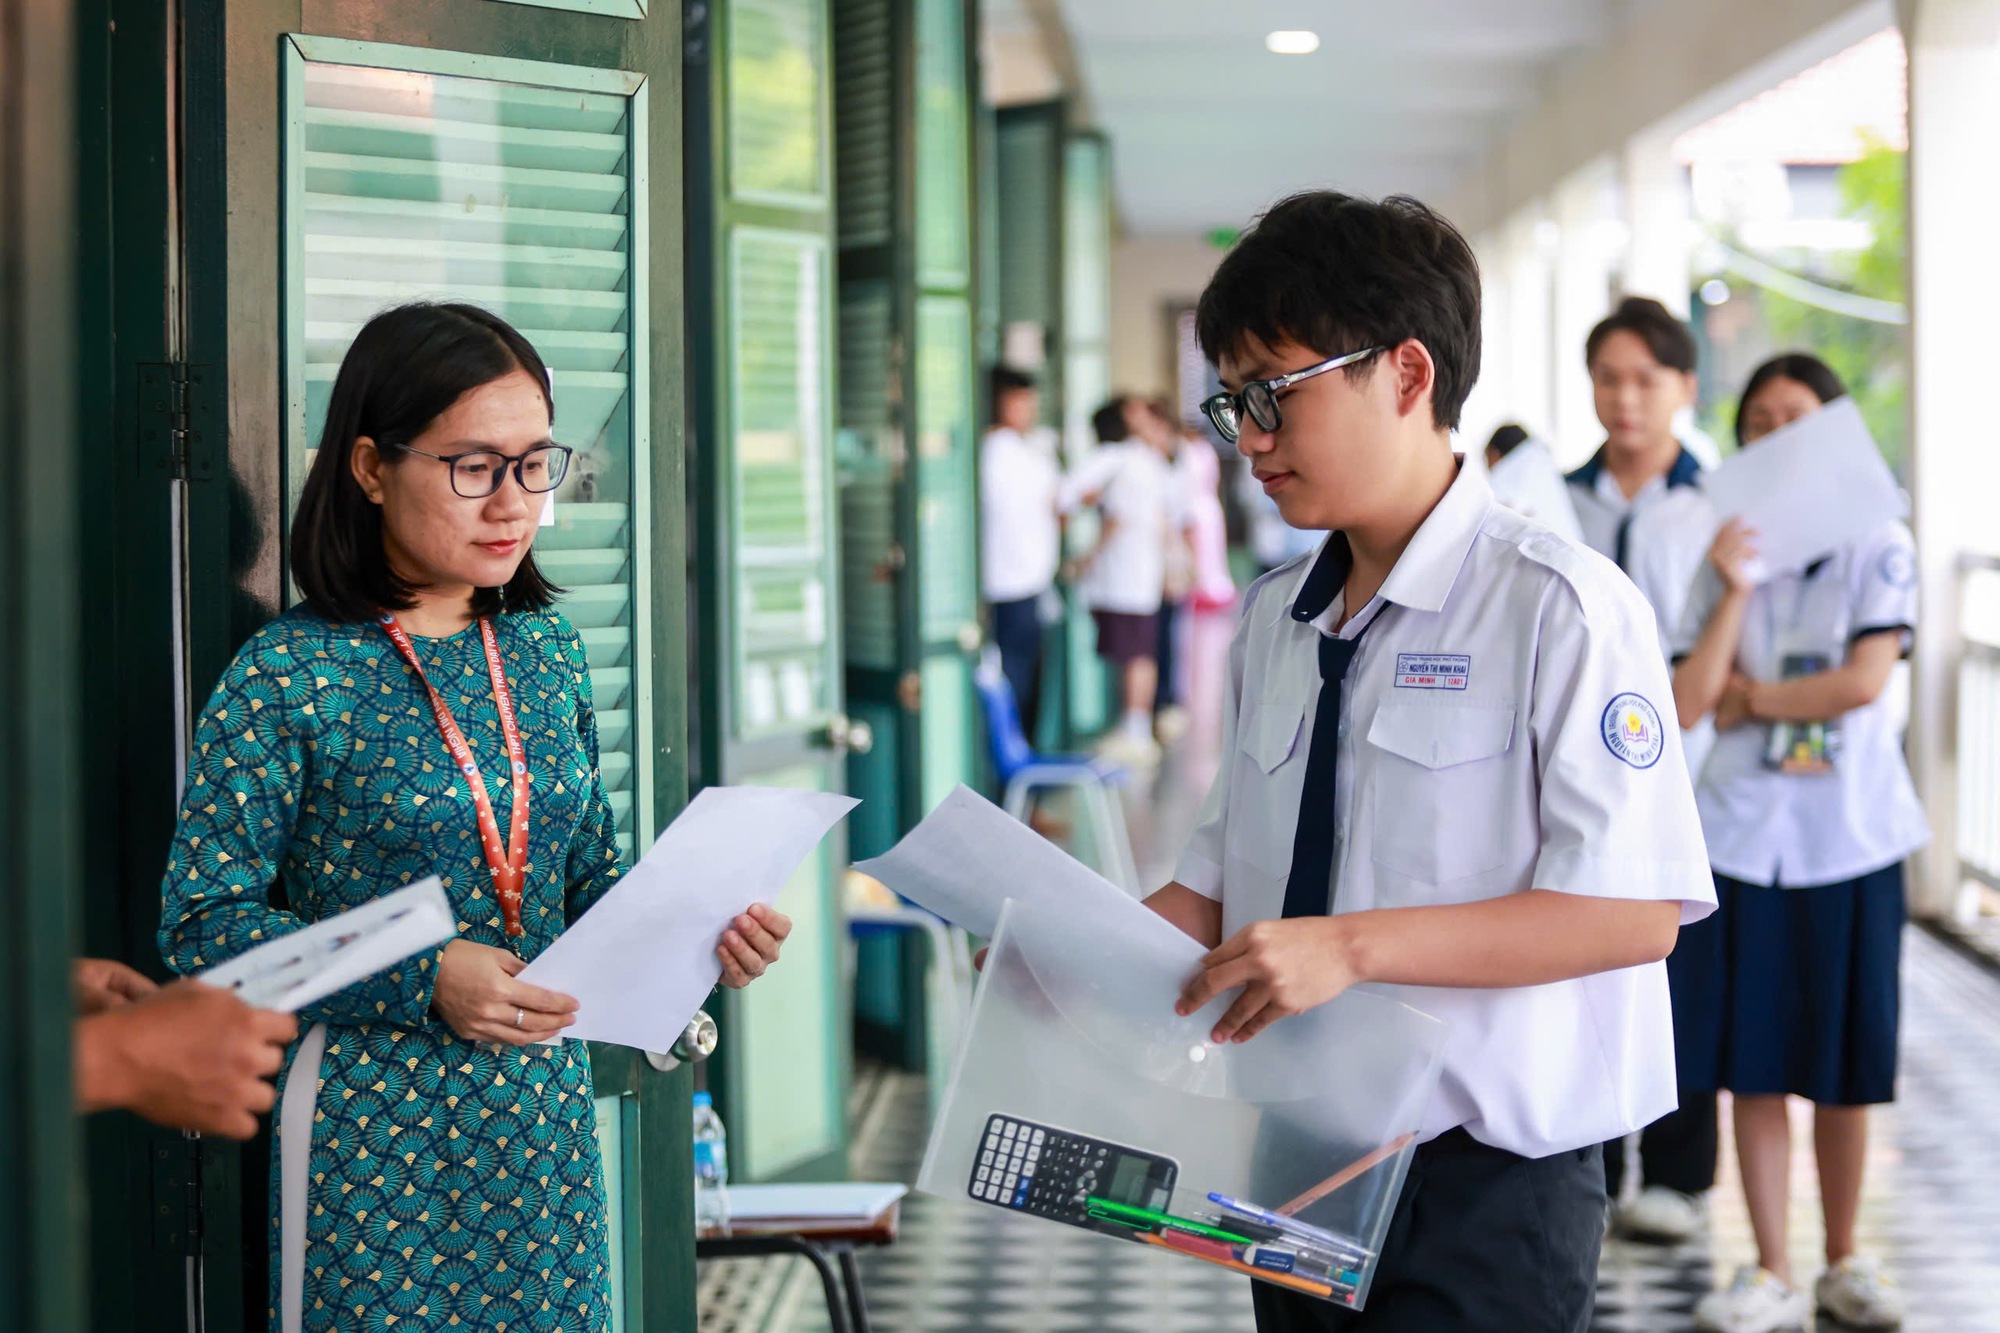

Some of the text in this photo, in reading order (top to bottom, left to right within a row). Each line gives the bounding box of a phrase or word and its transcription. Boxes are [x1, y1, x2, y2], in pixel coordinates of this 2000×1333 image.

[1439, 664, 1453, 673] MINH
[1453, 665, 1466, 674] KHAI
[1405, 676, 1417, 684] GIA
[508, 733, 522, 755] THPT
